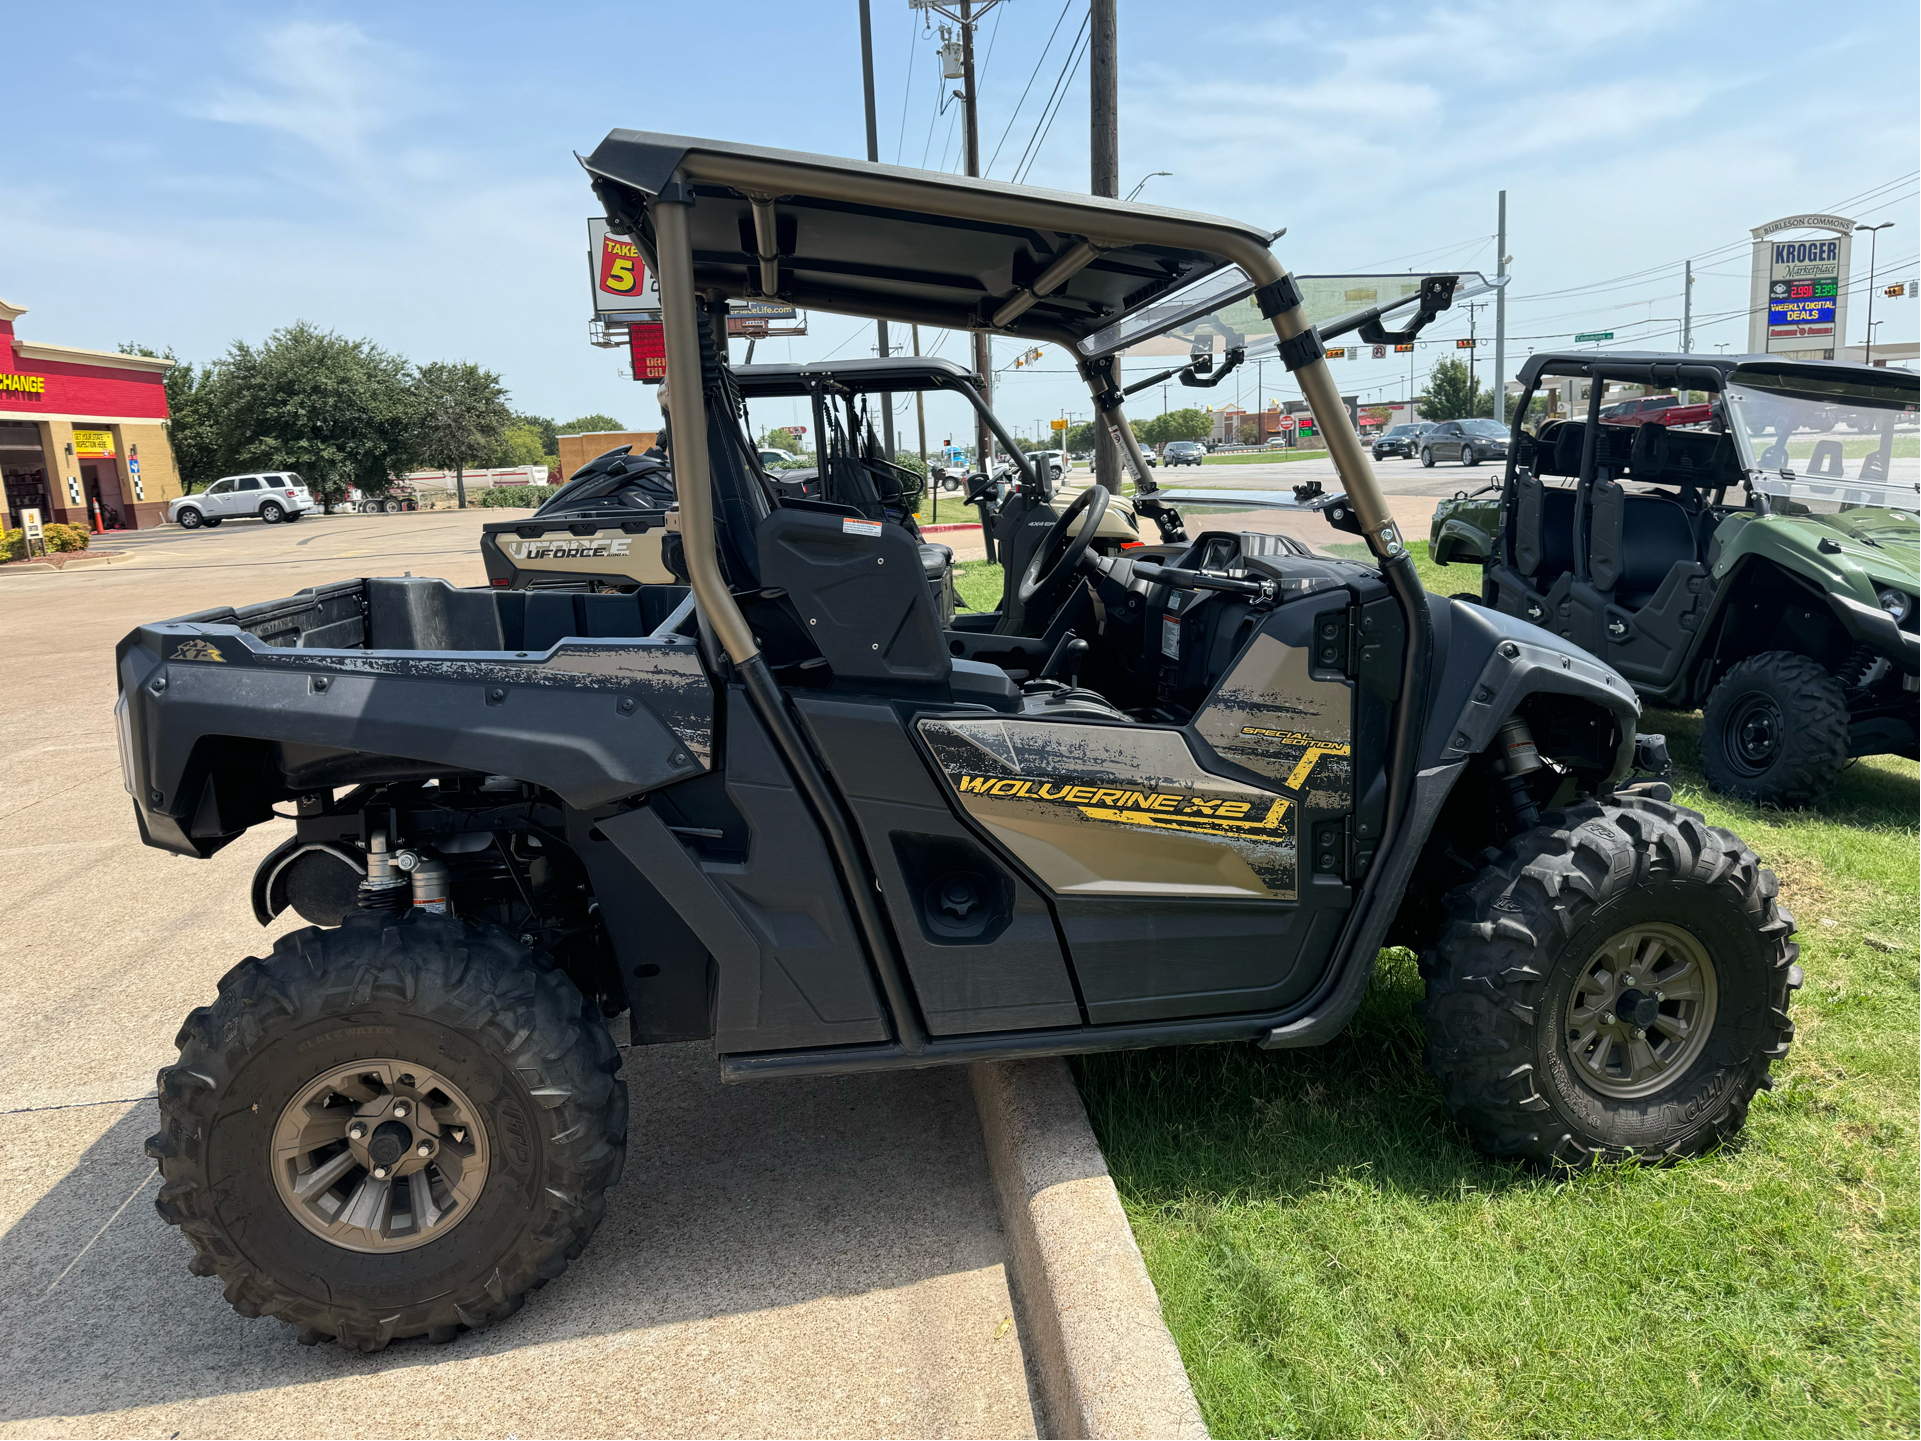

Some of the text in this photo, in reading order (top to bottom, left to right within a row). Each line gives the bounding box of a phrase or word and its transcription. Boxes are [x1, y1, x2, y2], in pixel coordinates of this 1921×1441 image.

[1763, 217, 1851, 235] BURLESON COMMONS
[605, 240, 638, 258] TAKE
[1775, 242, 1837, 264] KROGER
[605, 258, 637, 293] 5
[1782, 264, 1836, 278] Marketplace
[1771, 301, 1836, 312] WEEKLY DIGITAL
[1787, 310, 1819, 321] DEALS
[646, 358, 666, 367] DRI
[527, 547, 607, 559] UFORCE
[1240, 726, 1310, 742] SPECIAL
[1281, 737, 1345, 751] EDITION
[957, 775, 1252, 818] WOLVERINE X2
